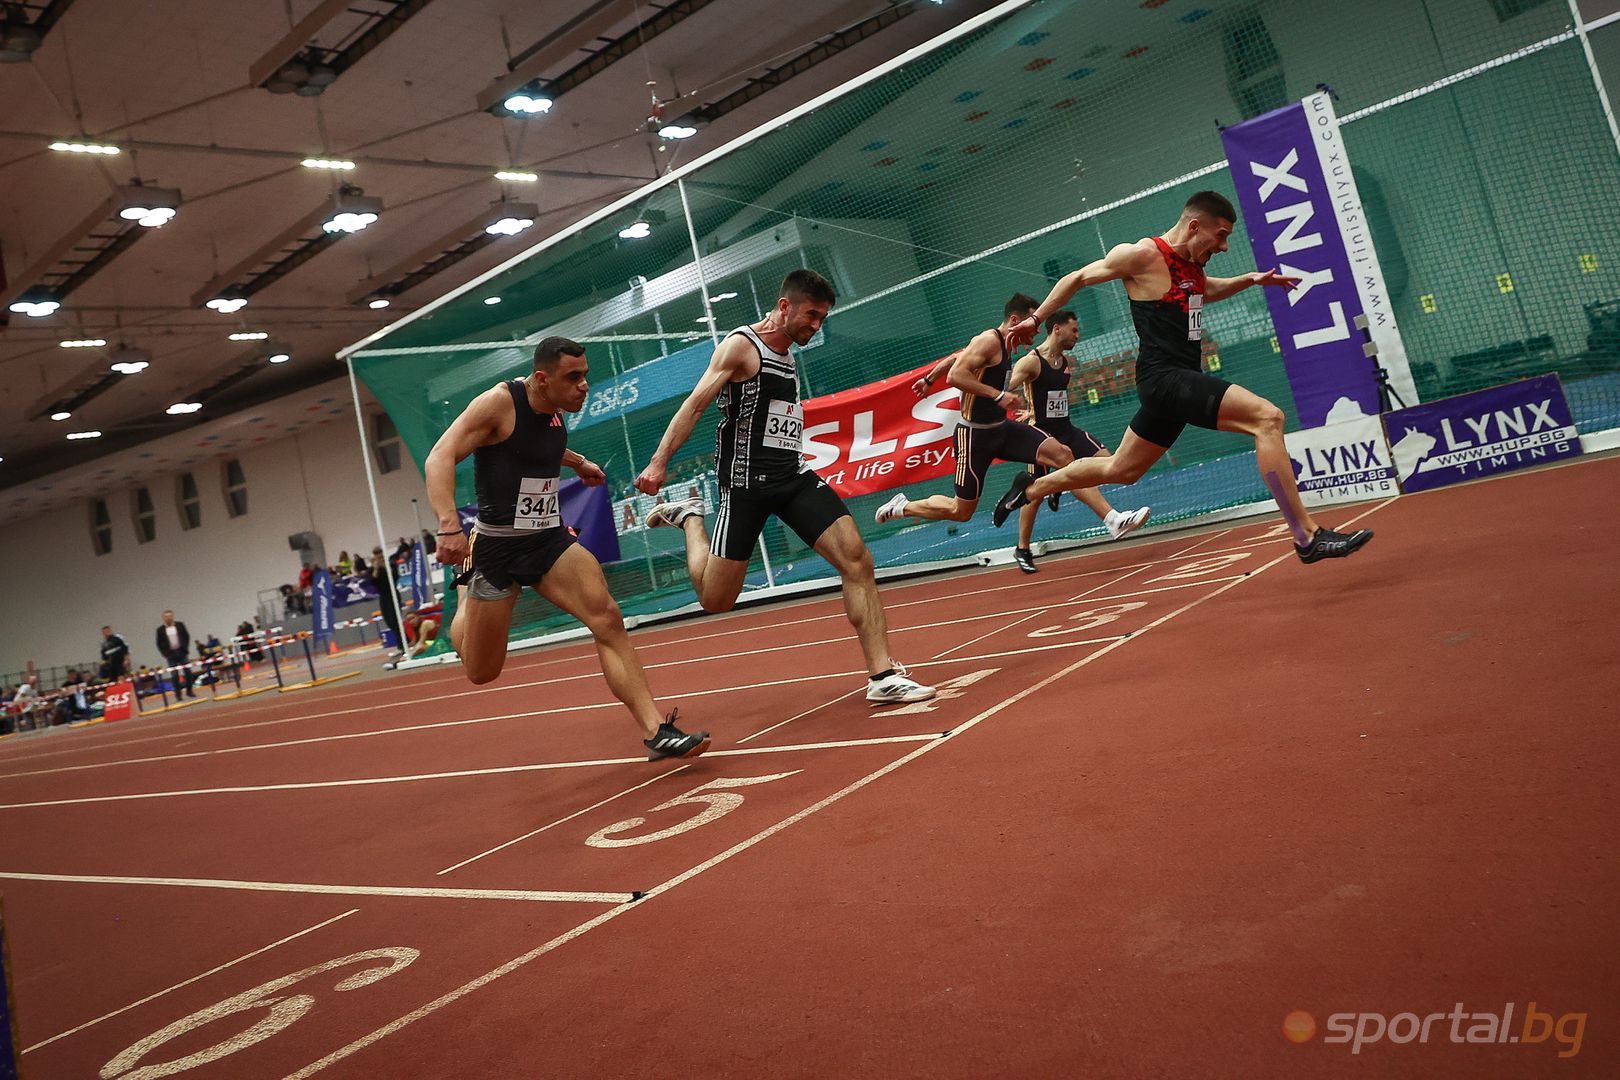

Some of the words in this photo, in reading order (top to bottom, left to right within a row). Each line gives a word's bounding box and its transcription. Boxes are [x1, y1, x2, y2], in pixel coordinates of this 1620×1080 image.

[1312, 96, 1387, 327] www.finishlynx.com
[1250, 147, 1351, 349] LYNX
[768, 417, 802, 439] 3429
[803, 387, 962, 472] SLS
[1440, 398, 1560, 452] LYNX
[1304, 440, 1382, 477] LYNX
[1437, 430, 1566, 466] WWW.HUP.BG
[1455, 440, 1571, 475] TIMING
[854, 460, 896, 481] life
[1304, 469, 1388, 490] WWW.HUP.BG
[519, 495, 557, 516] 3412
[1316, 480, 1391, 499] TIMING
[1141, 552, 1252, 585] 2
[1027, 601, 1148, 638] 3
[868, 667, 1002, 719] 4
[584, 769, 804, 848] 5
[98, 946, 420, 1080] 6
